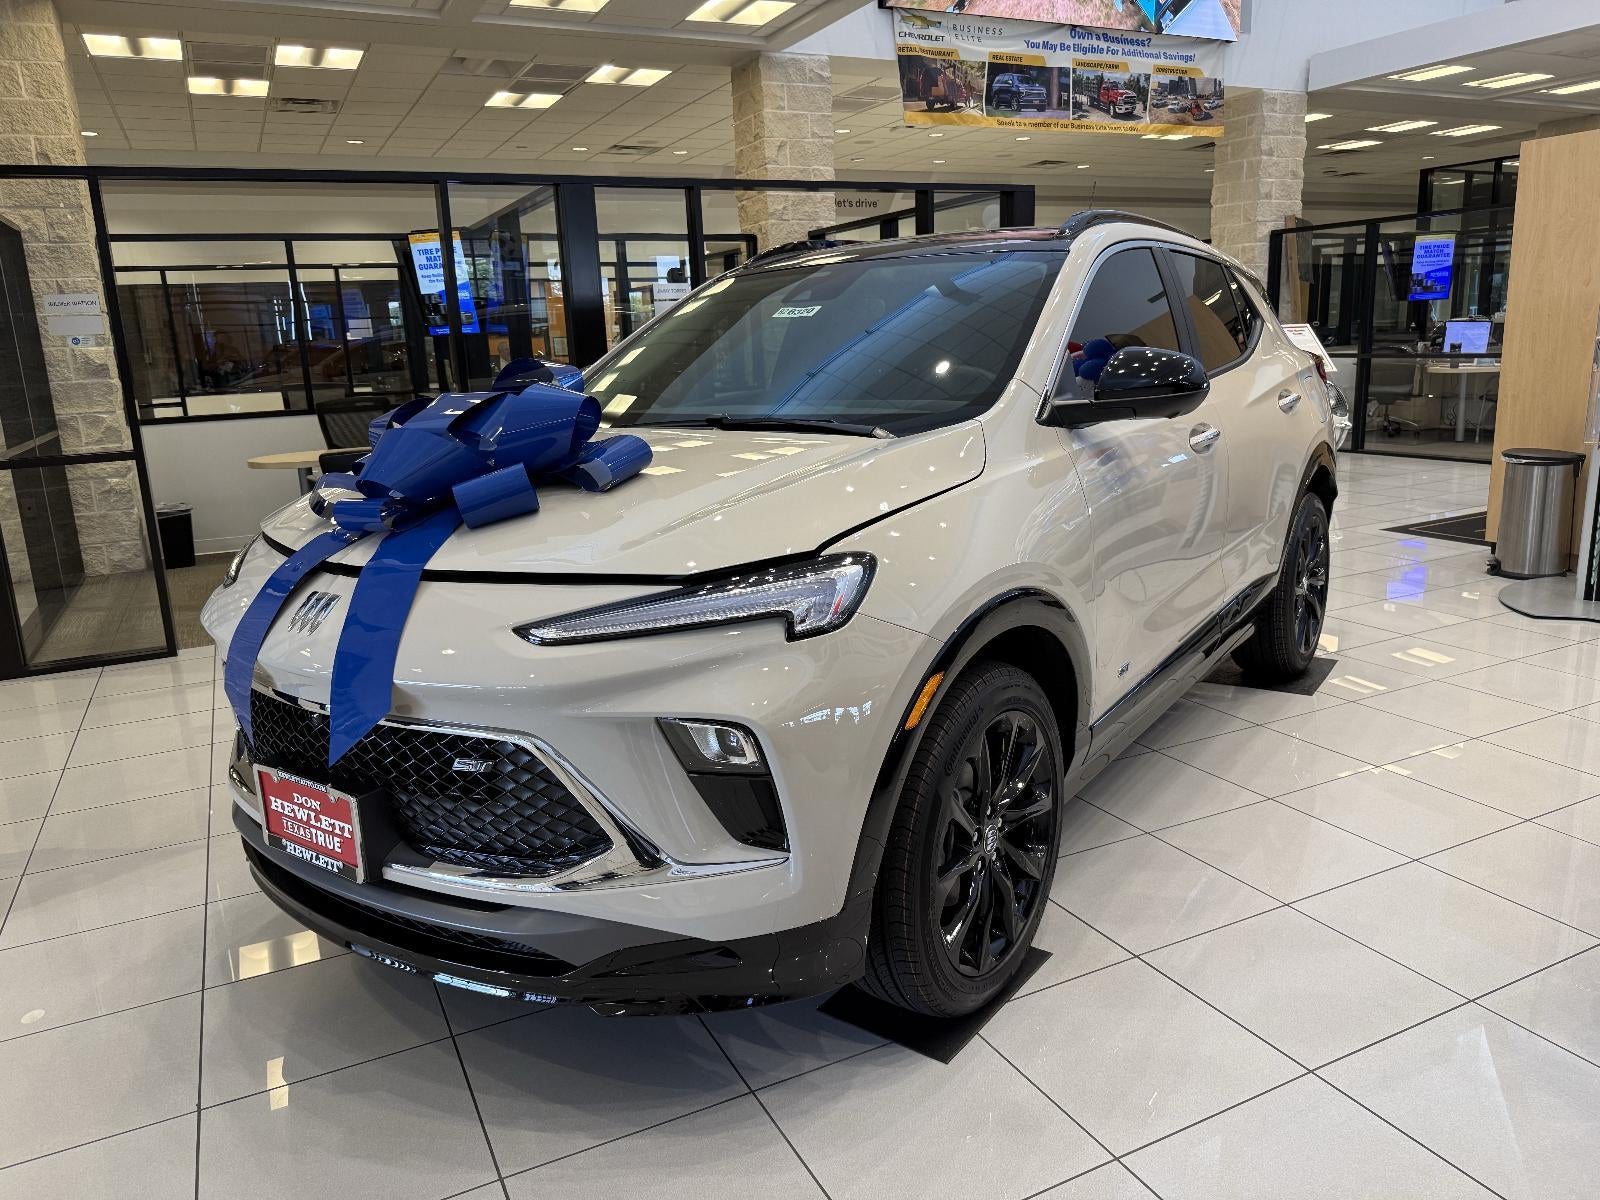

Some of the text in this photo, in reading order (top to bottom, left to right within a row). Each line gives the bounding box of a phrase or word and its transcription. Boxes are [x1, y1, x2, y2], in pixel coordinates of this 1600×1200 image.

[898, 31, 946, 42] CHEVROLET
[952, 23, 1003, 36] BUSINESS
[1070, 28, 1152, 47] Own a Business?
[954, 33, 982, 43] ELITE
[1024, 40, 1196, 63] You May Be Eligible For Additional Savings!
[834, 197, 878, 208] let's drive
[293, 792, 321, 812] DON
[268, 795, 353, 839] HEWLETT
